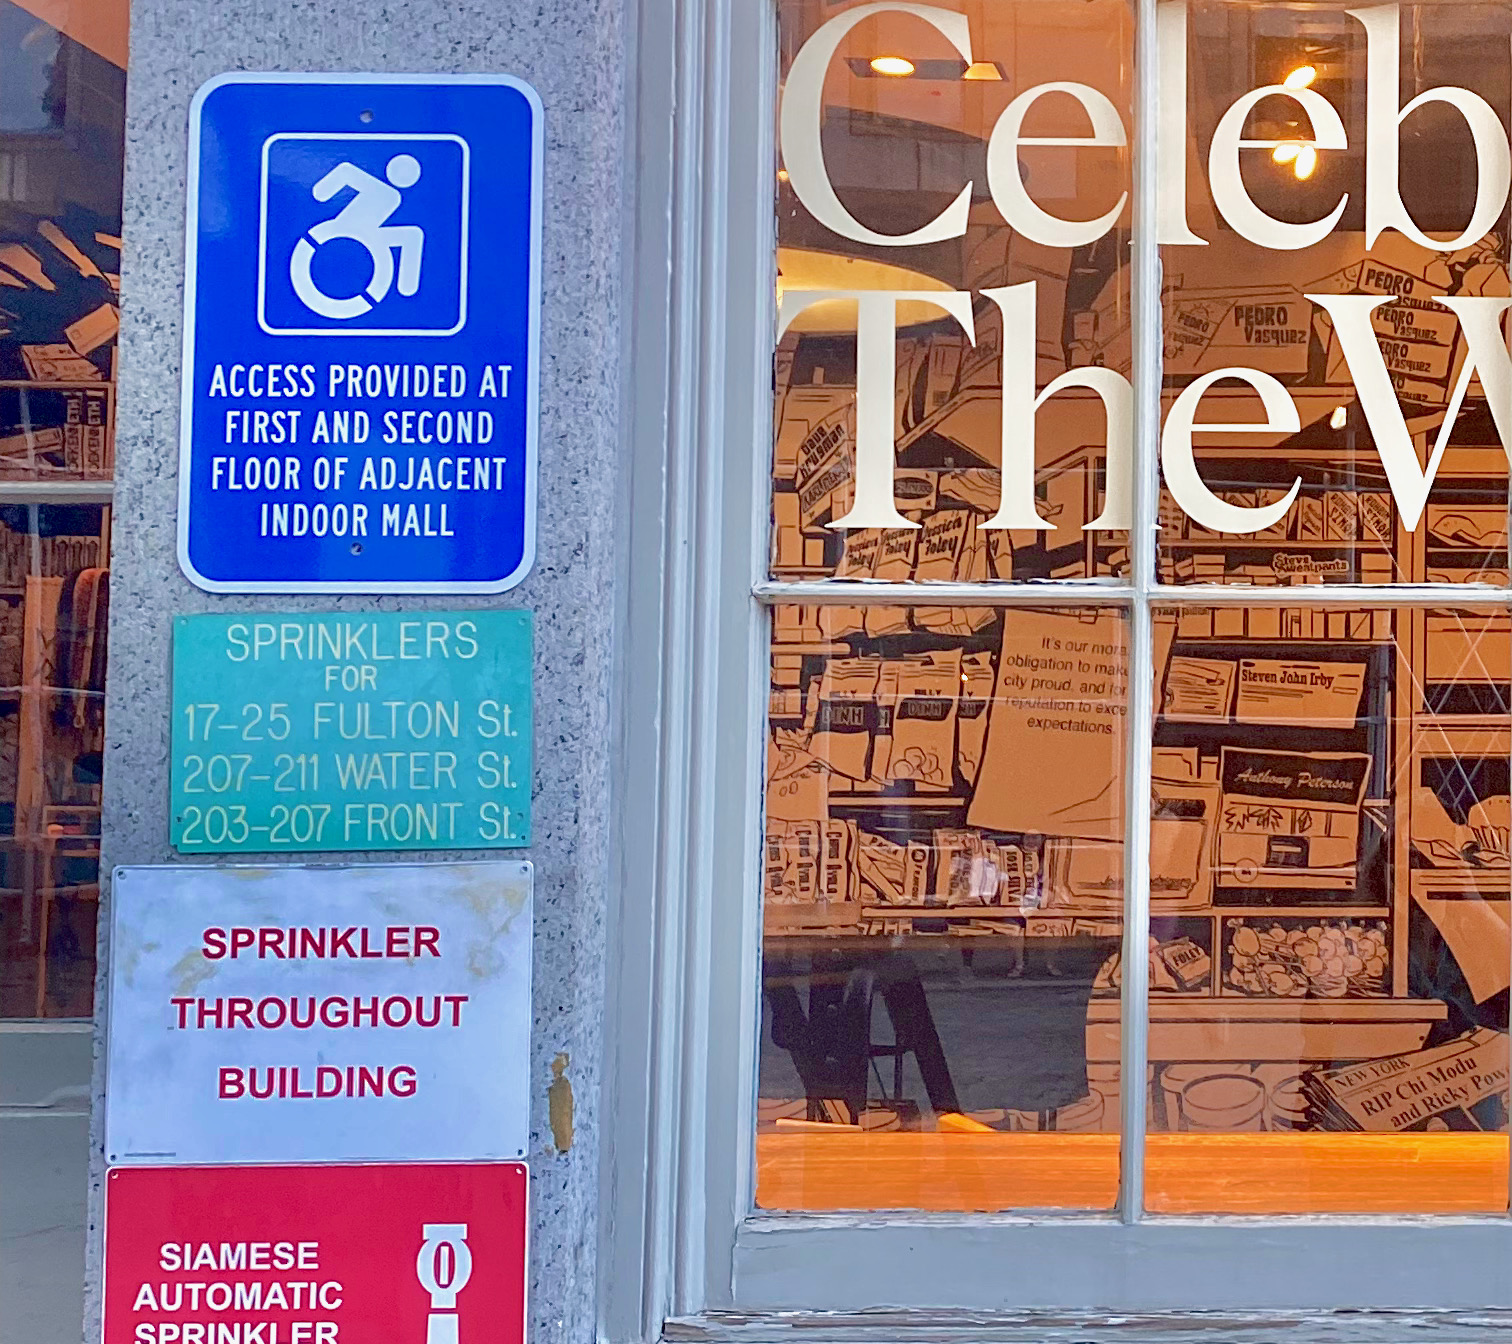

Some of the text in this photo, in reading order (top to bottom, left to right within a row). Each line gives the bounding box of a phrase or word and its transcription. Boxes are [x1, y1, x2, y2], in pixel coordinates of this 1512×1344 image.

[1365, 268, 1414, 295] PEDRO
[1234, 306, 1288, 327] PEDRO
[1376, 307, 1414, 325] PEDRO
[1244, 324, 1307, 346] Vasquez
[1380, 341, 1408, 358] EDRO
[209, 364, 512, 397] ACCESS PROVIDED AT
[226, 411, 493, 443] FIRST AND SECOND
[212, 457, 506, 490] FLOOR OF ADJACENT
[261, 504, 454, 536] INDOOR MALL
[227, 622, 479, 661] SPRINKLERS
[1065, 641, 1088, 652] our
[1092, 644, 1128, 655] mora
[326, 665, 378, 691] FOR
[1007, 654, 1073, 671] obligation
[1078, 659, 1091, 673] to
[1242, 669, 1277, 684] Steven
[1280, 670, 1307, 685] John
[1004, 674, 1028, 690] city
[1080, 681, 1105, 695] and
[185, 700, 517, 740] 17-25 FULTON St.
[1078, 700, 1091, 713] to
[1095, 703, 1128, 716] exce
[184, 751, 517, 792] 207-211 WATER St.
[182, 802, 517, 844] 203-207 FRONT St.
[202, 927, 440, 959] SPRINKLER
[171, 996, 468, 1028] THROUGHOUT
[219, 1066, 417, 1098] BUILDING
[1336, 1056, 1411, 1088] NEW YORK
[1360, 1057, 1478, 1116] RIP Chi Modu
[1390, 1067, 1510, 1128] and Ricky Pow
[160, 1242, 318, 1270] SIAMESE
[133, 1282, 342, 1310] AUTOMATIC
